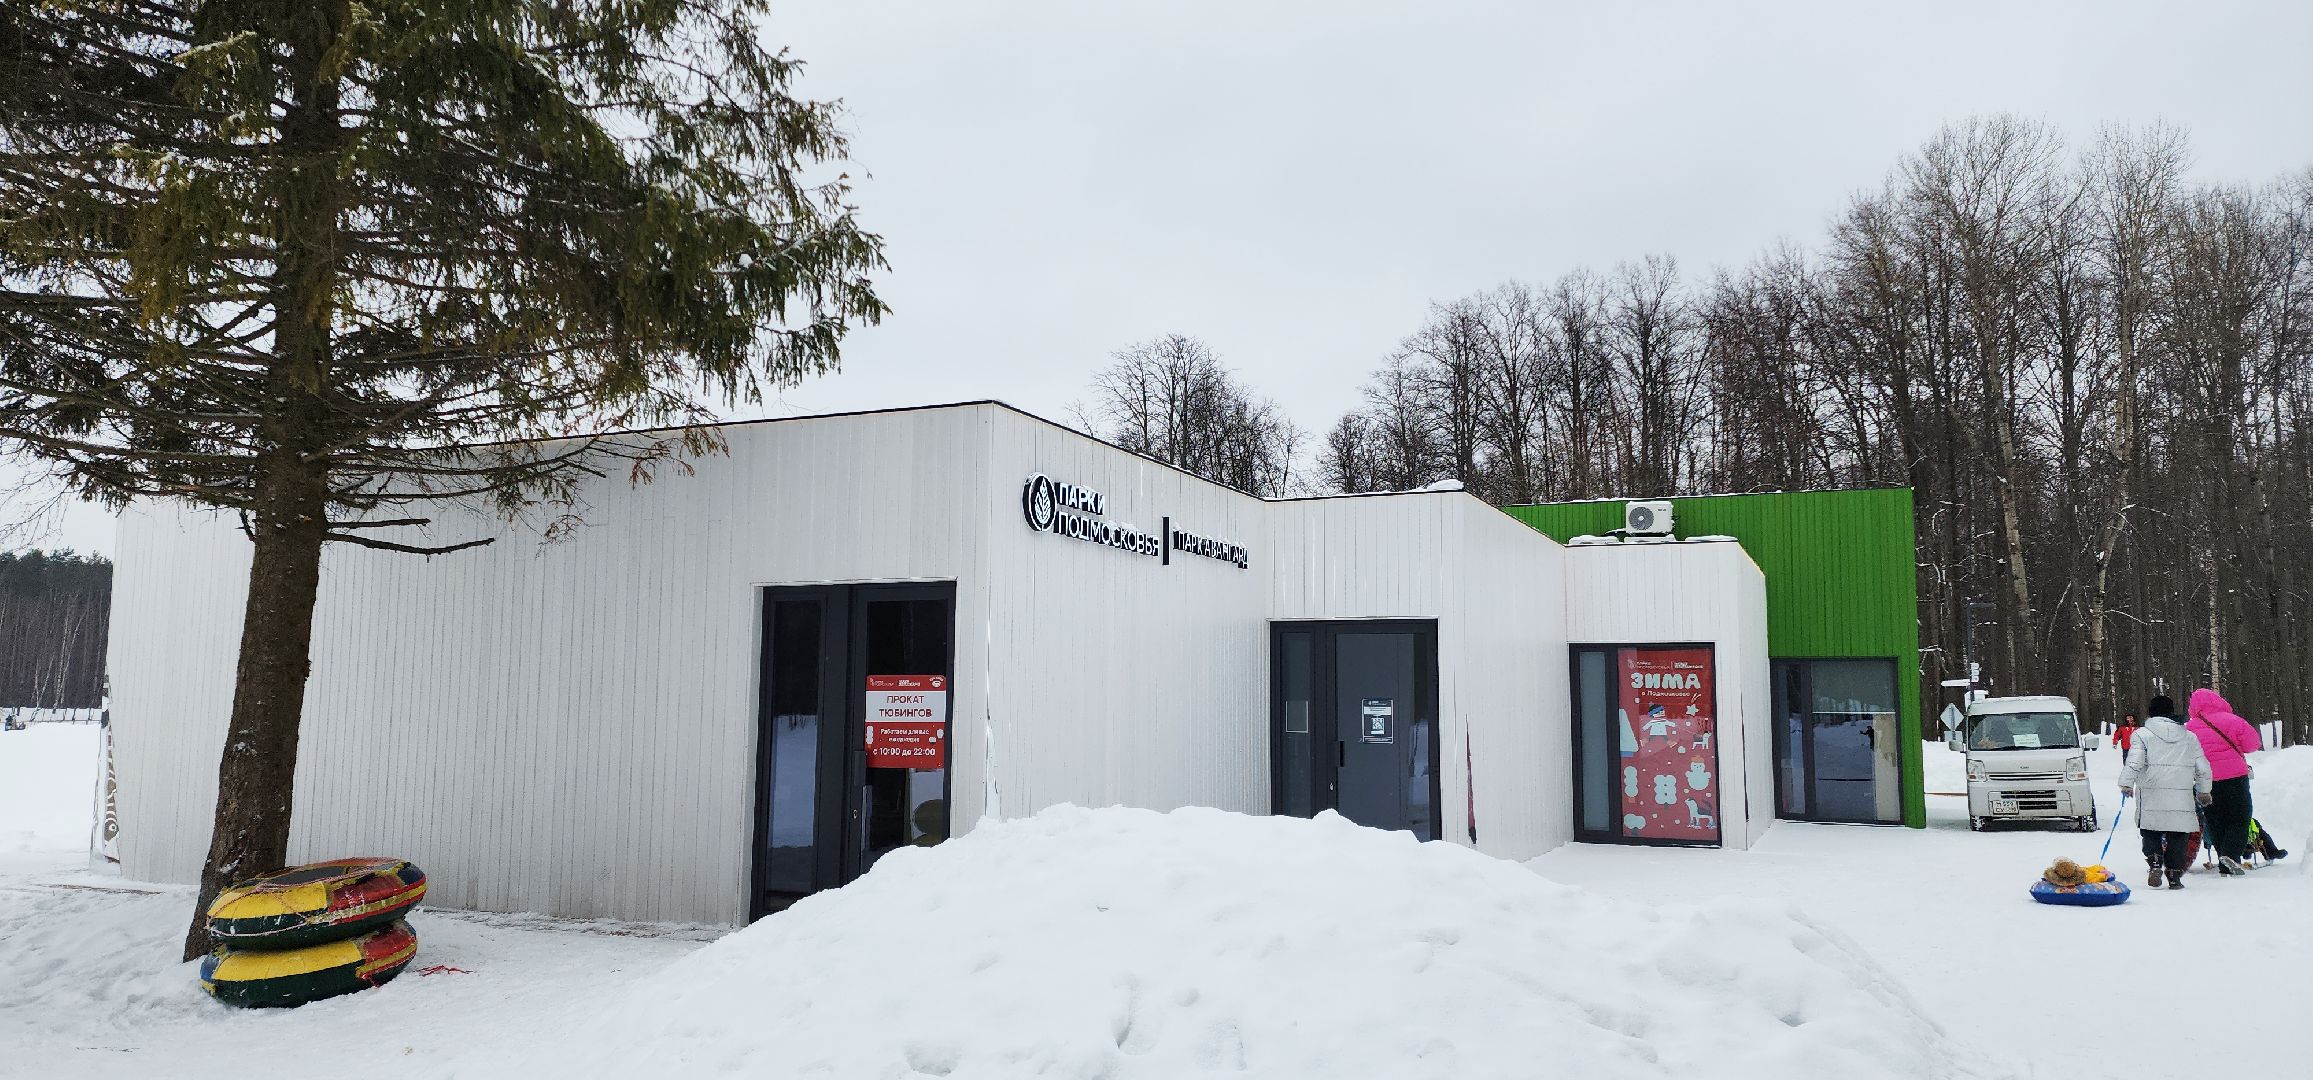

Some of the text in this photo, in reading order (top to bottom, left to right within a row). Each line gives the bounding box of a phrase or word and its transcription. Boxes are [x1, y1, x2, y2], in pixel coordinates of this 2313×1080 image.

[1054, 482, 1106, 515] ПАРКИ
[1054, 511, 1160, 556] ПОДМОСКОВЬЯ
[1173, 529, 1203, 556] ПАРК
[1630, 672, 1702, 690] ЗИМА
[886, 695, 925, 704] ПРОКАТ
[879, 708, 933, 718] ТЮБИНГОВ
[879, 747, 901, 756] 10:00
[902, 749, 912, 757] до
[913, 747, 936, 756] 22:00
